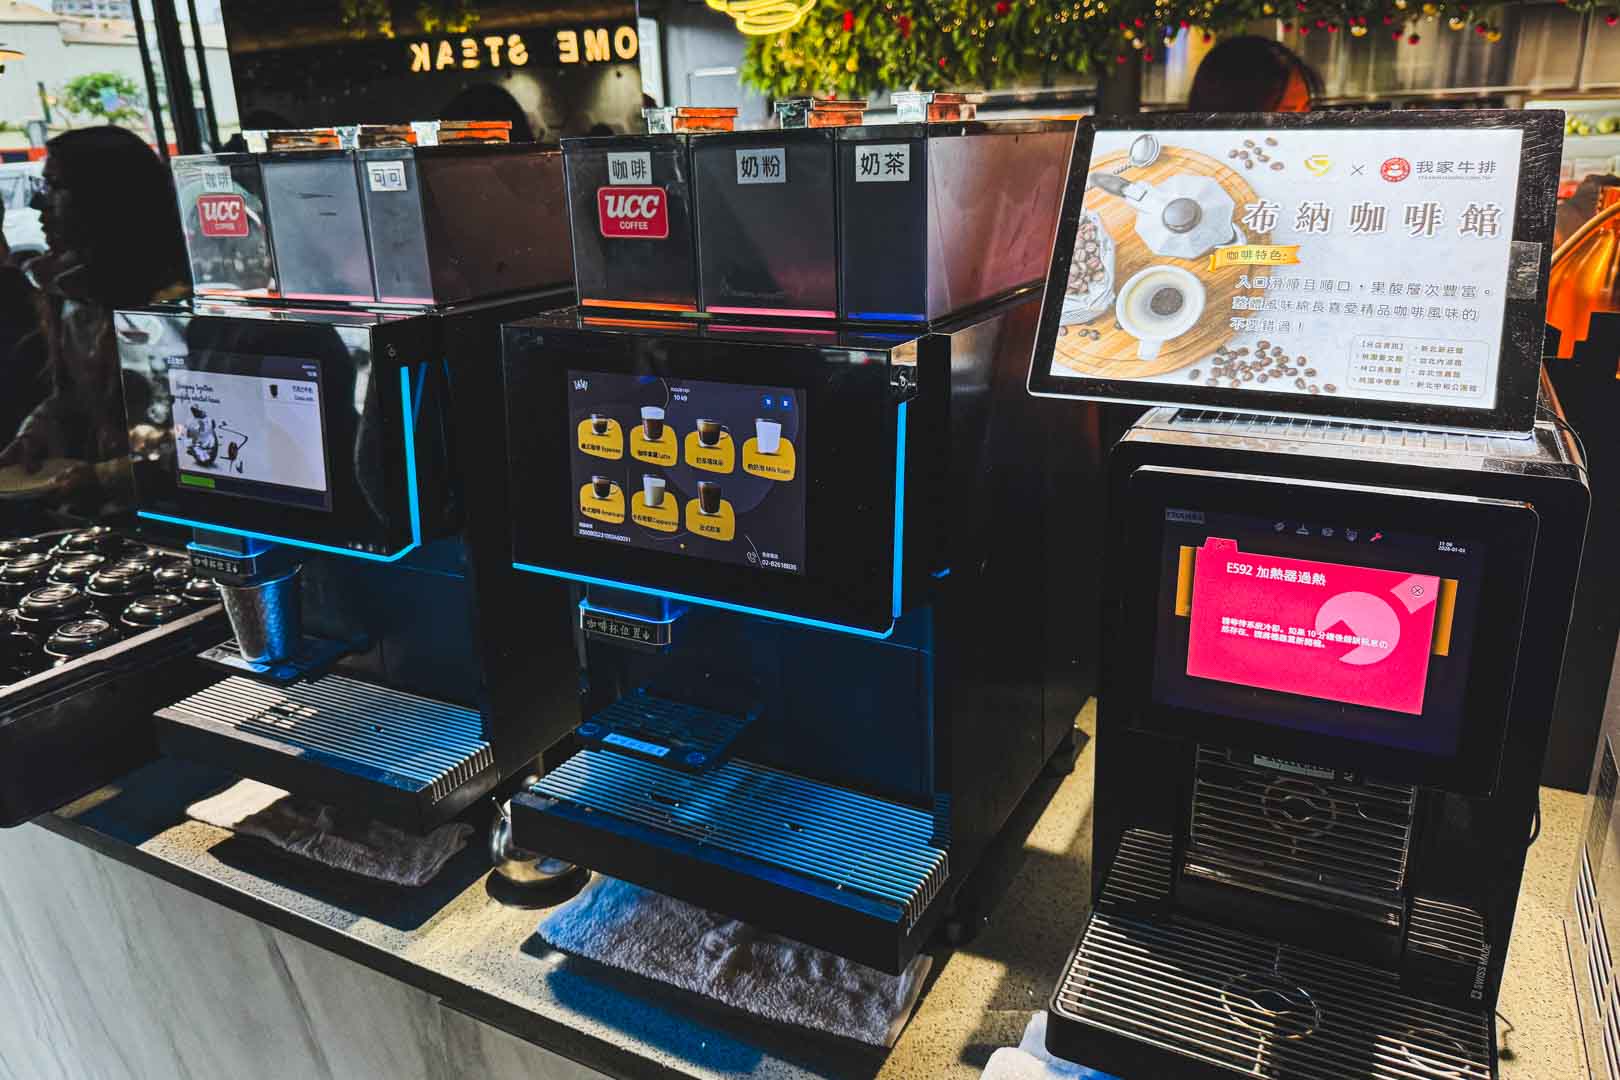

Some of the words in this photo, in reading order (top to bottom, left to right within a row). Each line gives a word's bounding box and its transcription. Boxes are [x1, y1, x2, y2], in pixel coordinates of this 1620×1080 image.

[611, 158, 647, 180] 咖啡
[740, 155, 782, 178] 奶粉
[859, 151, 906, 176] 奶茶
[1415, 160, 1497, 174] 我家牛排
[370, 168, 402, 186] 可可
[619, 221, 649, 231] COFFEE
[1243, 198, 1503, 238] 布納咖啡館
[1226, 561, 1254, 576] E592
[1255, 565, 1327, 586] 加熱器過熱
[1307, 629, 1317, 638] 10
